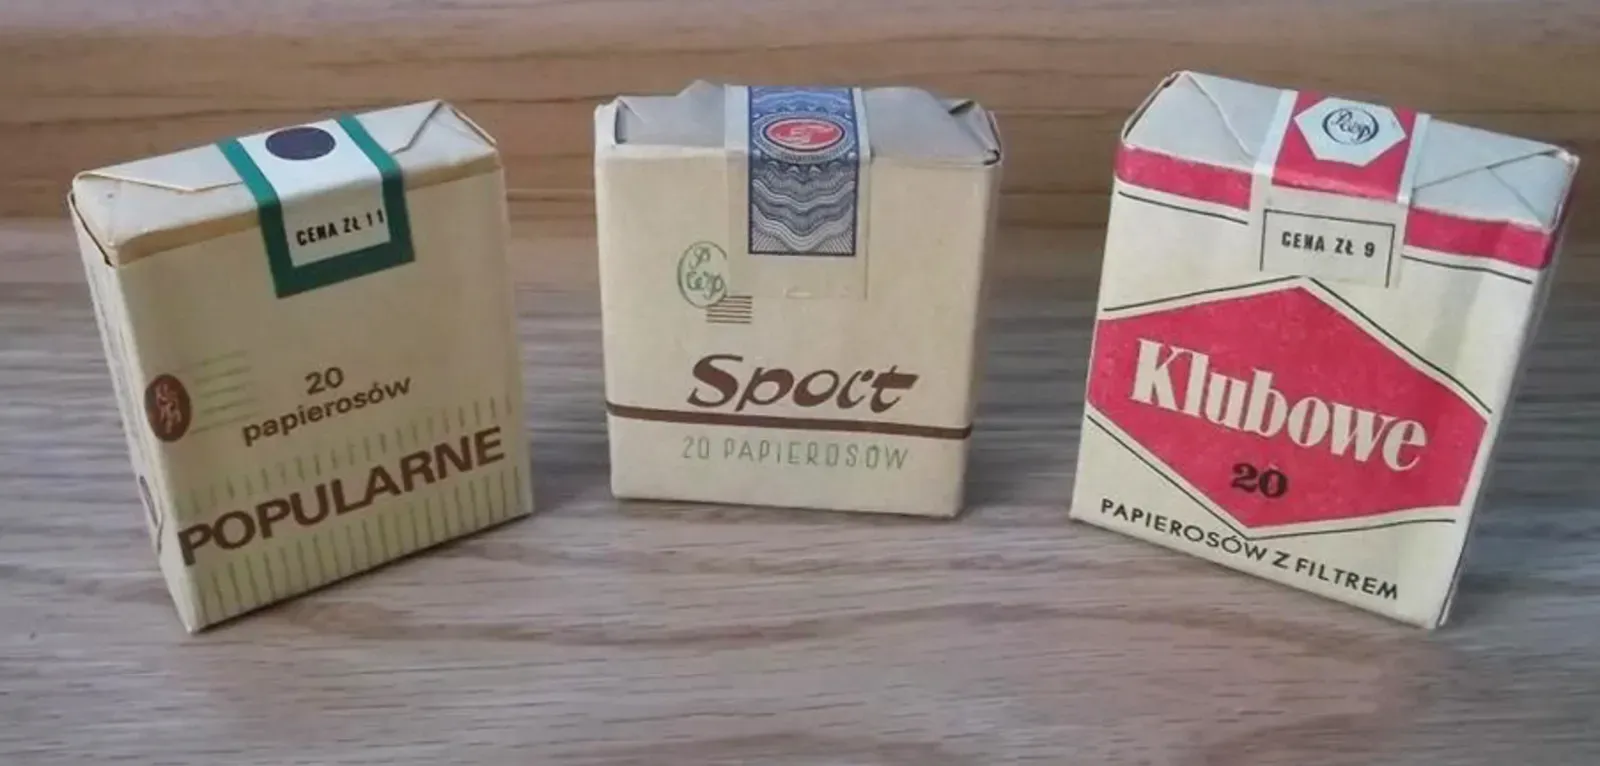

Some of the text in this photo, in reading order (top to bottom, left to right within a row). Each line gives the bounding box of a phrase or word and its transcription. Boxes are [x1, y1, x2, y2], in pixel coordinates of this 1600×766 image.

[296, 220, 339, 246] CENA
[1281, 231, 1325, 252] CENA
[1363, 241, 1375, 258] 9
[305, 366, 344, 395] 20
[242, 377, 411, 447] papierosów
[1132, 338, 1426, 472] Klubowe
[682, 436, 710, 459] 20
[178, 427, 505, 566] POPULARNE
[1231, 463, 1288, 498] 20
[1101, 498, 1398, 600] PAPIEROSÓW Z FILTREM
